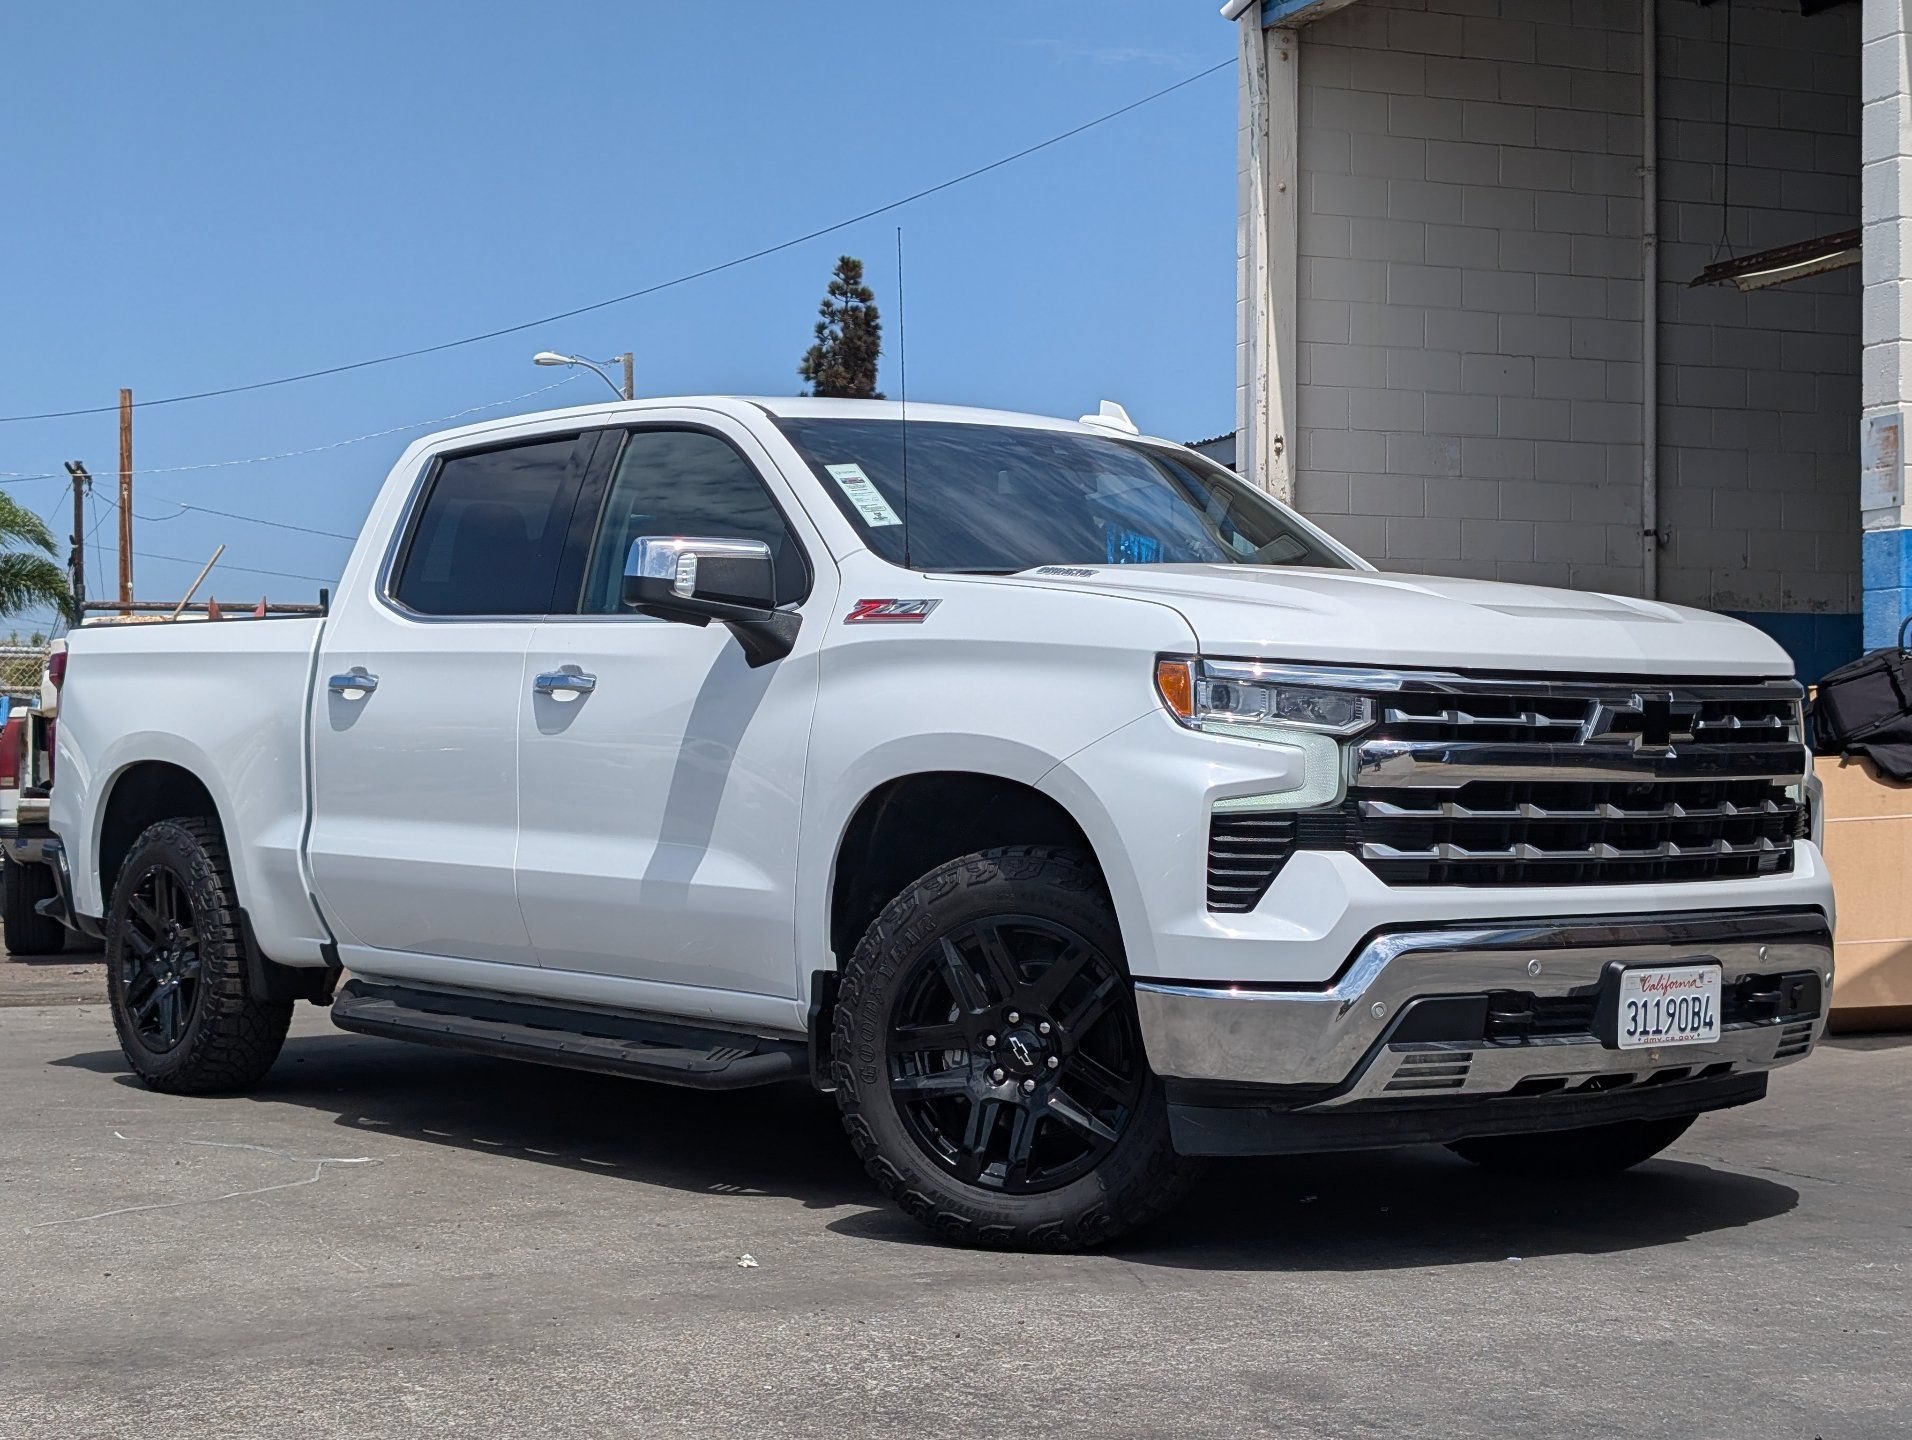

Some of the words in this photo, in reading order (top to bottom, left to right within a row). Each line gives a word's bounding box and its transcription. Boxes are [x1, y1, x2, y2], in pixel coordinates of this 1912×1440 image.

[843, 599, 943, 625] Z71
[1642, 974, 1703, 997] California
[1626, 994, 1714, 1037] 31190B4
[1643, 1034, 1695, 1044] dmv.ca.gov
